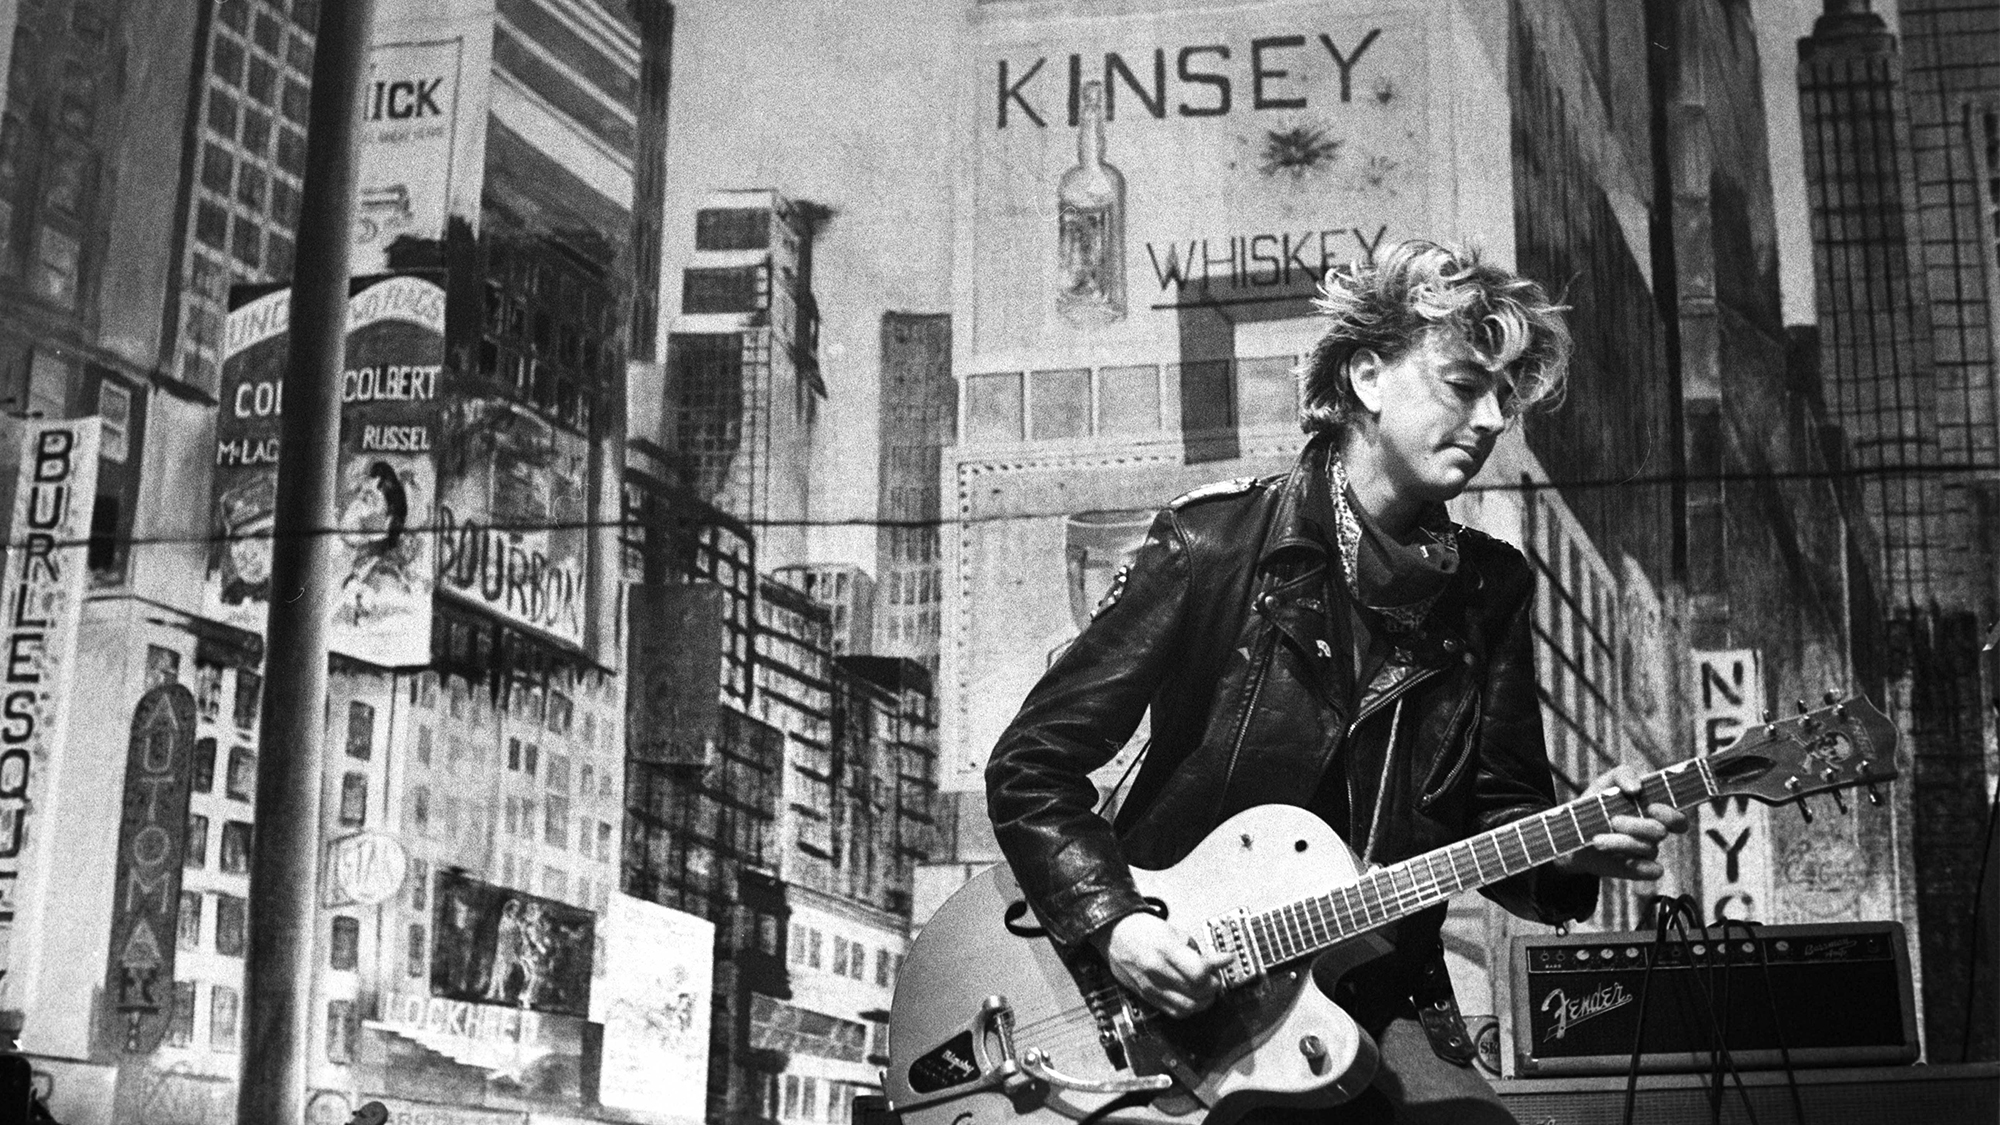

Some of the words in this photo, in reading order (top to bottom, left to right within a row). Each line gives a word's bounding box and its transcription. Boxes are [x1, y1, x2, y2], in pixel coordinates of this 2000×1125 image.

[363, 77, 443, 122] ICK
[997, 28, 1382, 129] KINSEY
[1145, 224, 1389, 292] WHISKEY
[342, 365, 443, 403] COLBERT
[439, 505, 583, 635] BOURBON
[1541, 981, 1634, 1042] Fender
